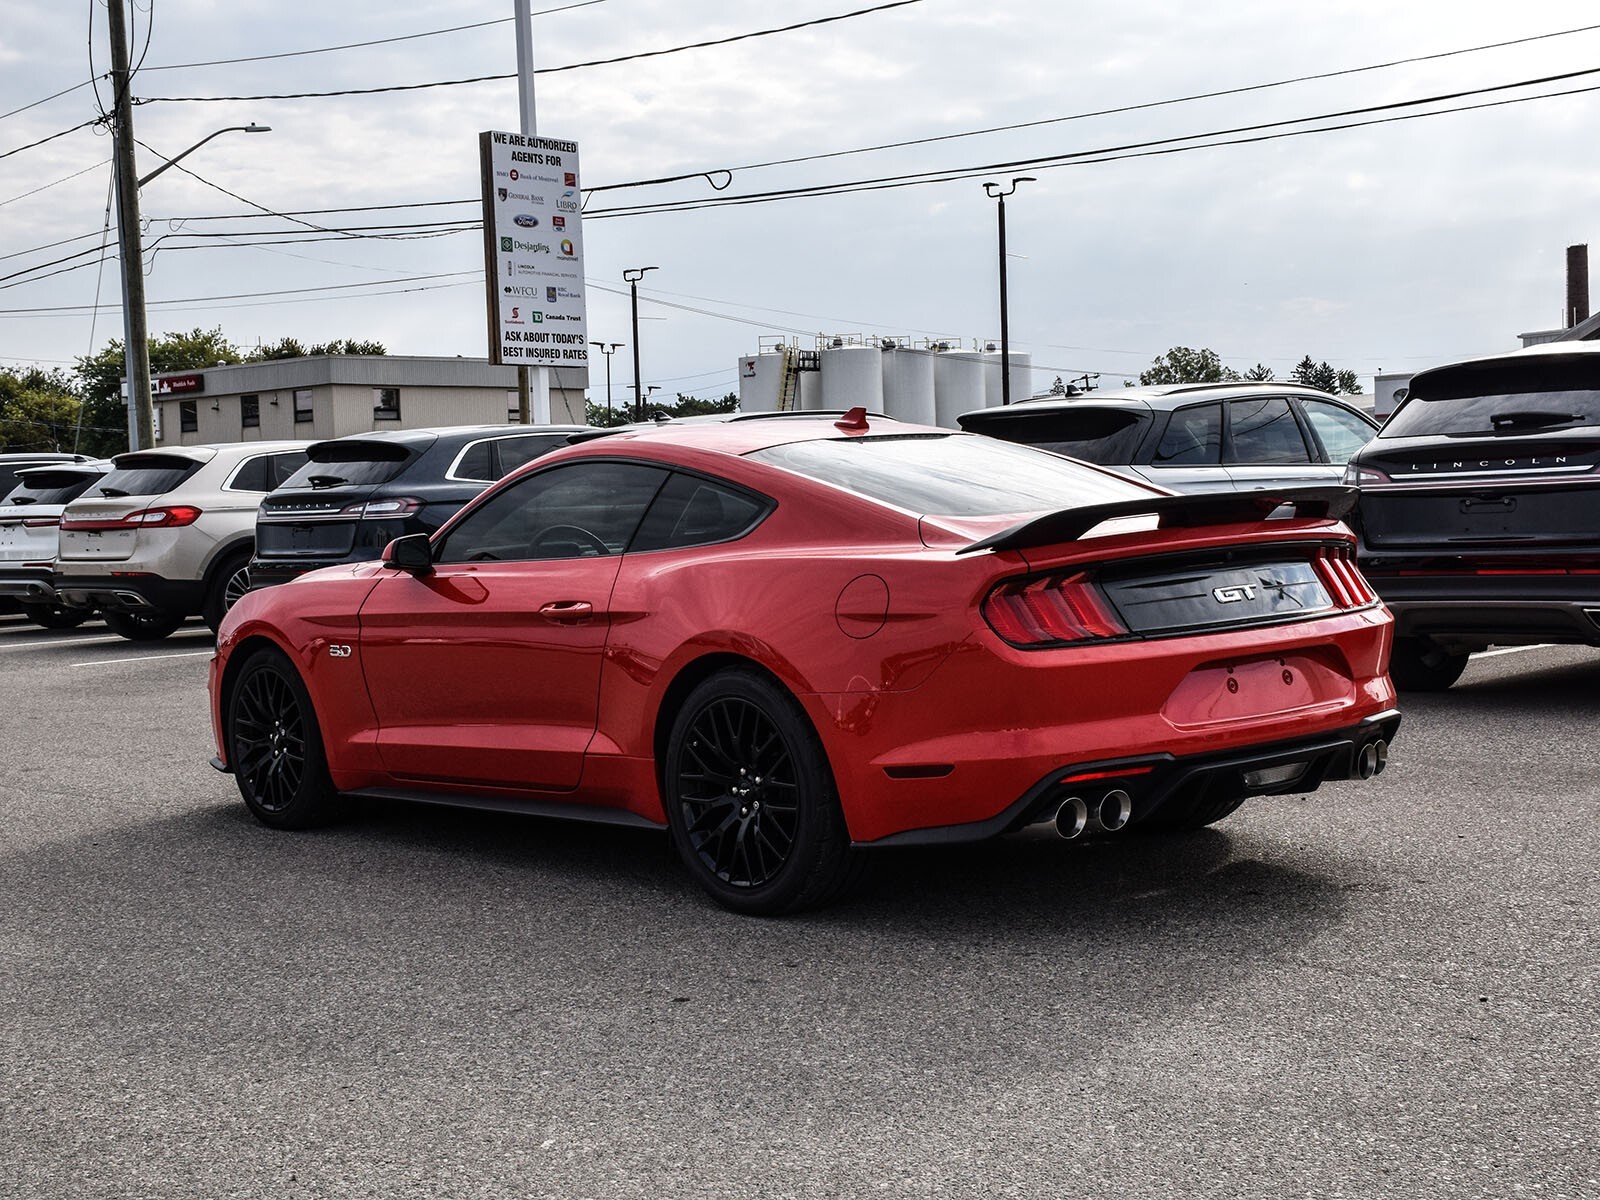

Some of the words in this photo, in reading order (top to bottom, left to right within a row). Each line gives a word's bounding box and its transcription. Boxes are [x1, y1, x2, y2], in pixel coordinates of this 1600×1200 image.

[493, 132, 507, 145] WE
[508, 134, 526, 147] ARE
[527, 137, 577, 153] AUTHORIZED
[511, 150, 544, 165] AGENTS
[545, 155, 562, 167] FOR
[538, 175, 559, 183] Montreal
[556, 199, 577, 210] LIBRO
[517, 215, 535, 226] Ford
[514, 240, 550, 253] Desjardins
[512, 286, 538, 296] WFCU
[545, 313, 565, 321] Canada
[505, 331, 521, 342] ASK
[523, 332, 550, 343] ABOUT
[551, 333, 584, 345] TODAY'S
[503, 346, 523, 358] BEST
[525, 348, 561, 359] INSURED
[562, 349, 588, 360] RATES
[1412, 456, 1567, 471] LINCOLN
[1212, 584, 1257, 604] GT
